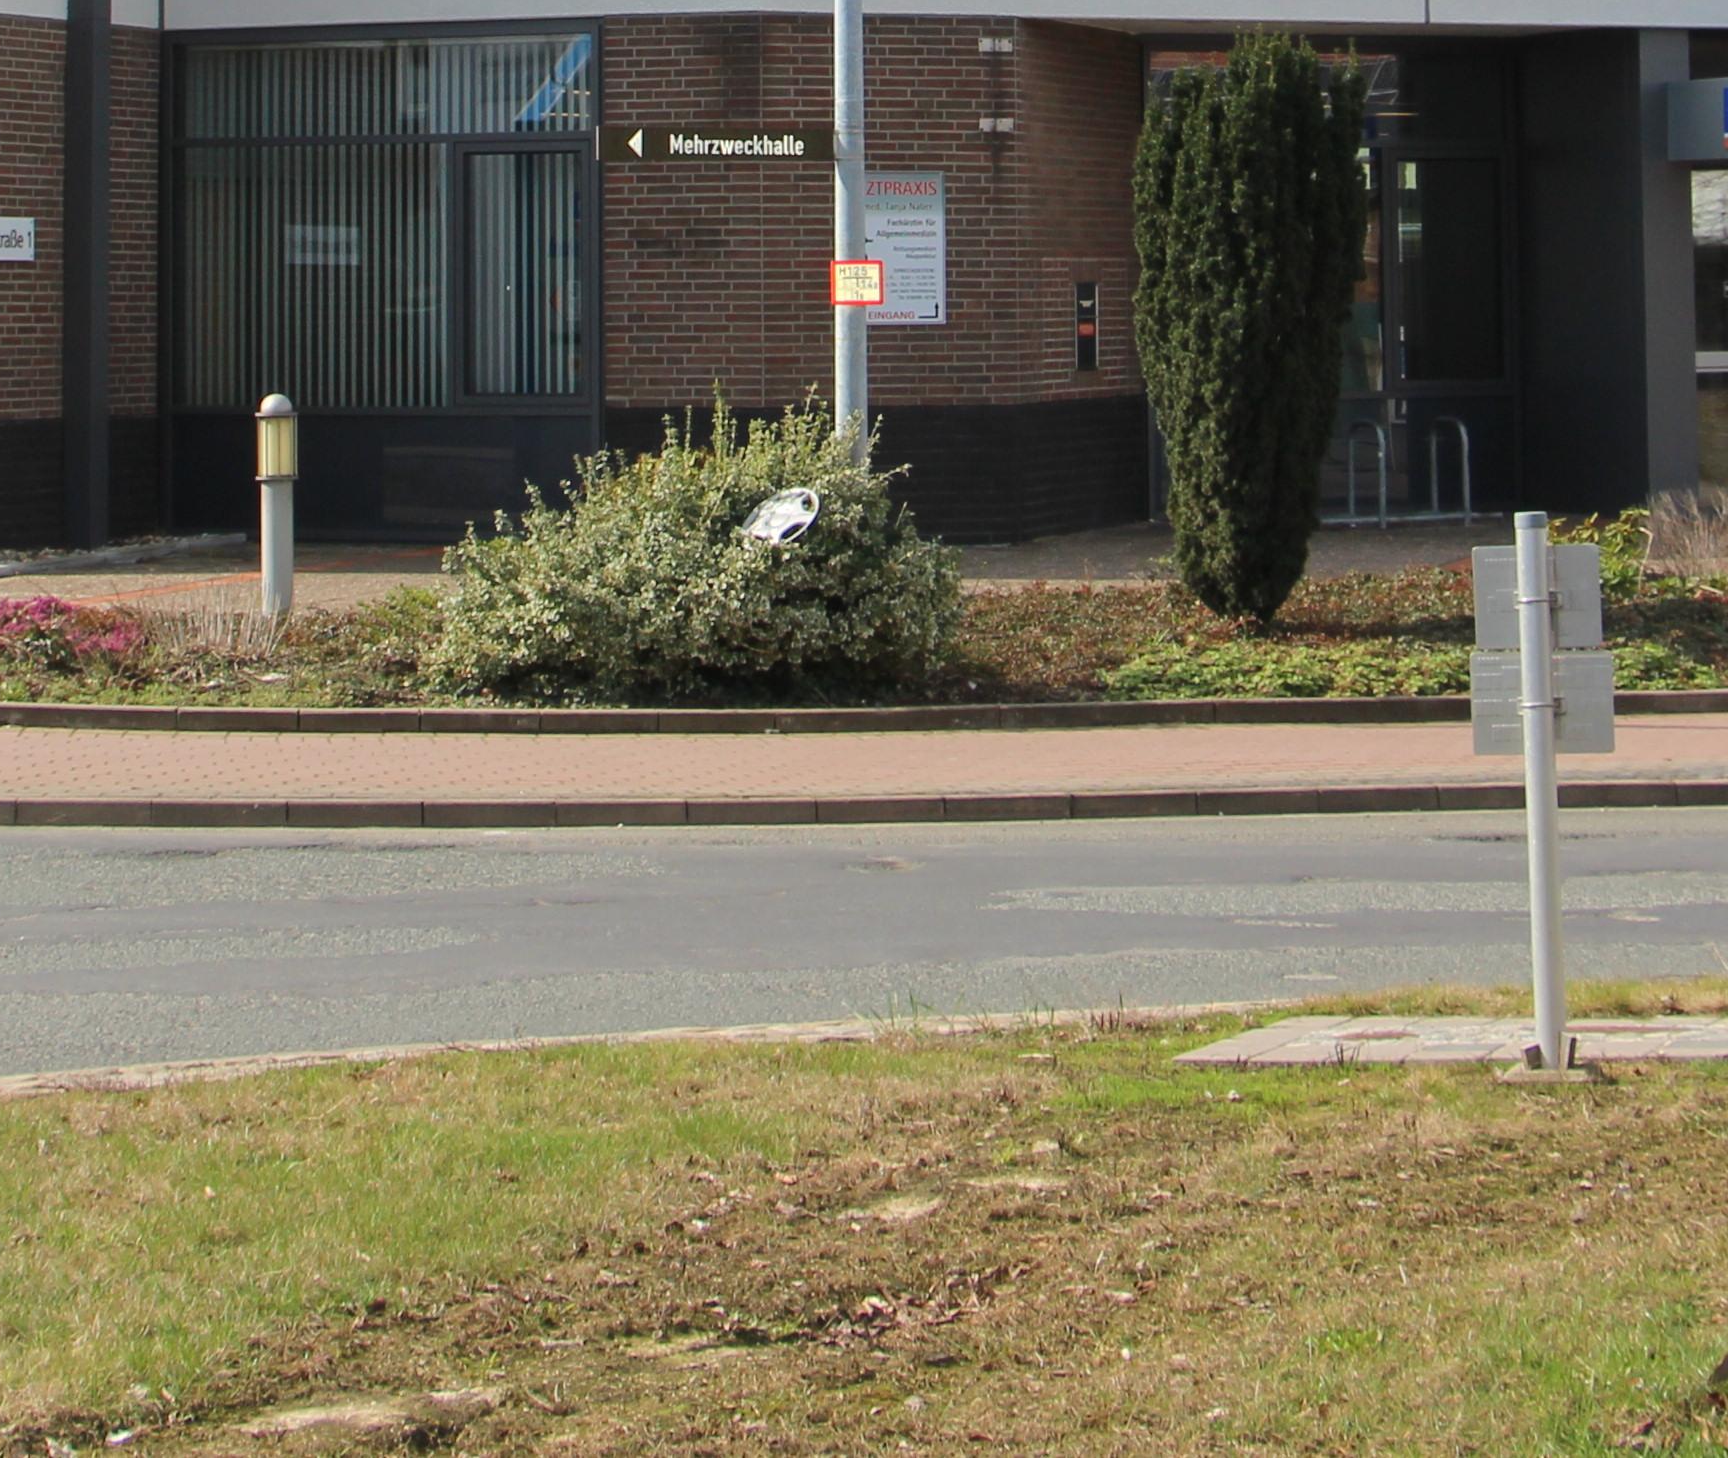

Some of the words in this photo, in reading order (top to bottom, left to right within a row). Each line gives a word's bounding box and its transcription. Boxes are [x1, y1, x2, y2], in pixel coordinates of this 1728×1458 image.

[669, 133, 805, 156] Mehrzweckhalle
[865, 181, 937, 196] ZTPRAXIS
[868, 311, 916, 320] EINGANG
